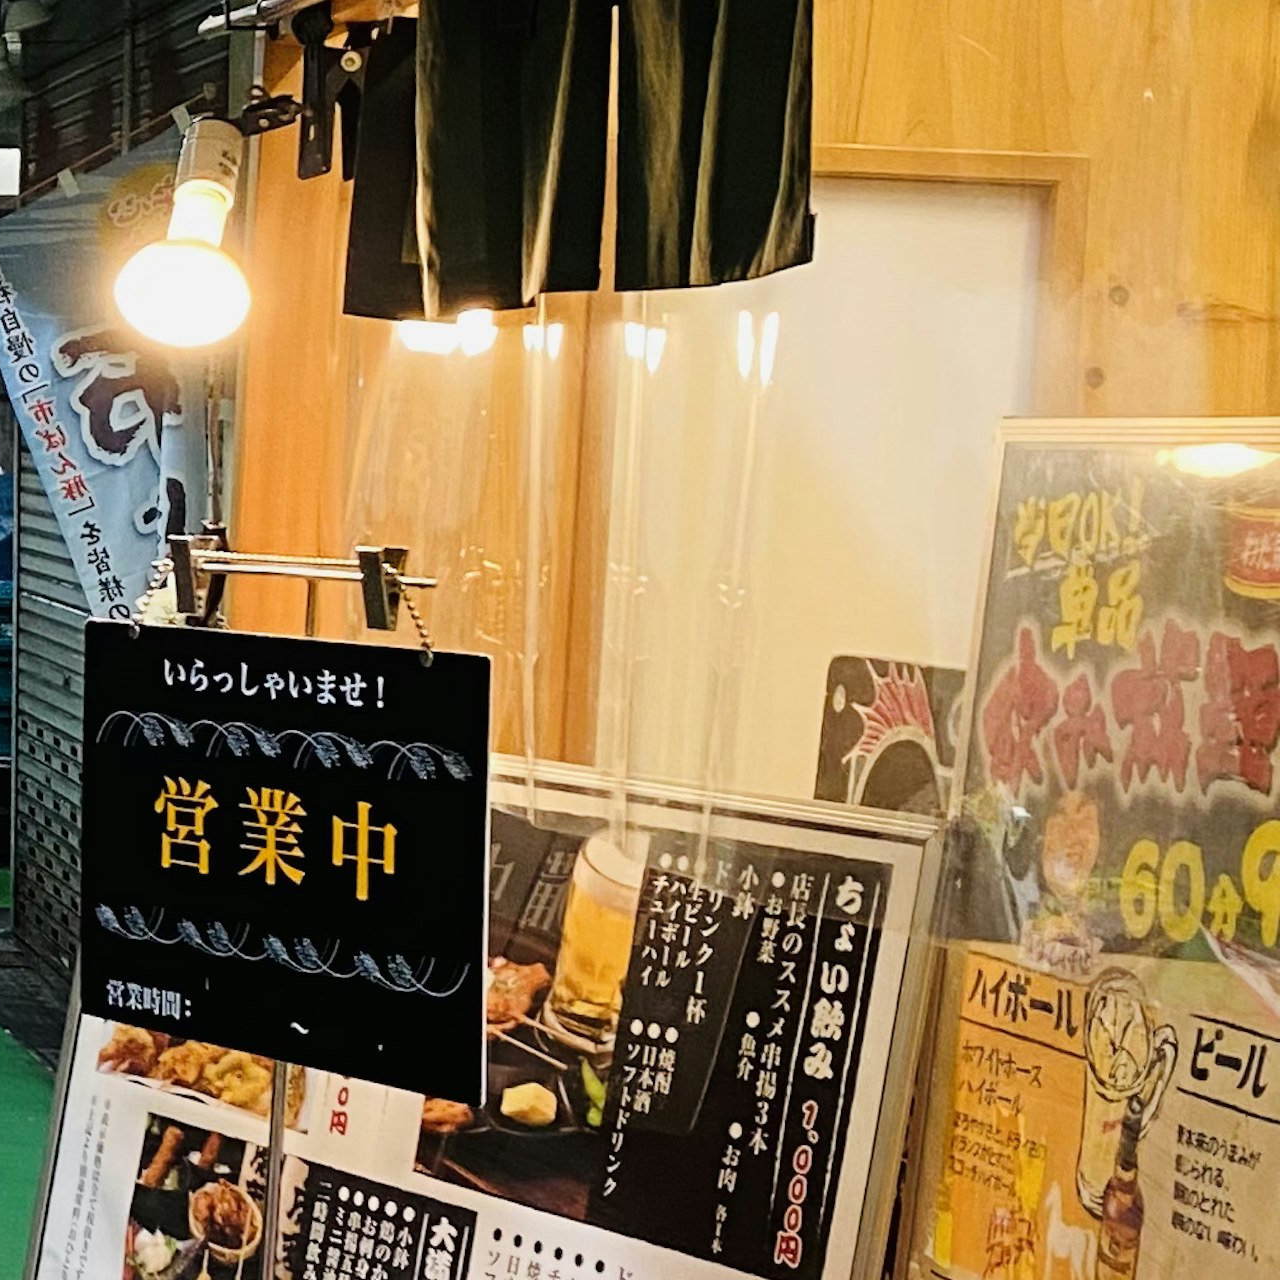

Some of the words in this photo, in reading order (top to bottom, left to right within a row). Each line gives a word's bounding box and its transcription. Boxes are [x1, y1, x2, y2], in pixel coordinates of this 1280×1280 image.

[162, 658, 386, 709] いらっしゃいませ!
[153, 775, 399, 902] 営業中
[731, 864, 760, 921] 小鉢
[640, 877, 670, 987] チューハイ
[656, 880, 687, 988] ハイボール
[756, 892, 785, 966] お野菜
[105, 978, 193, 1020] 営業時間:
[804, 874, 866, 1082] ちょい飲み
[968, 968, 1081, 1038] ハイボール
[632, 1045, 658, 1114] 日本酒
[653, 1047, 677, 1096] 焼酎
[736, 1031, 758, 1083] 魚介
[1189, 1029, 1268, 1099] ビール
[602, 1043, 641, 1197] ソフトドリンク
[958, 1079, 1024, 1117] ハイボール
[718, 1144, 741, 1194] お肉
[391, 1225, 413, 1273] 小鉢
